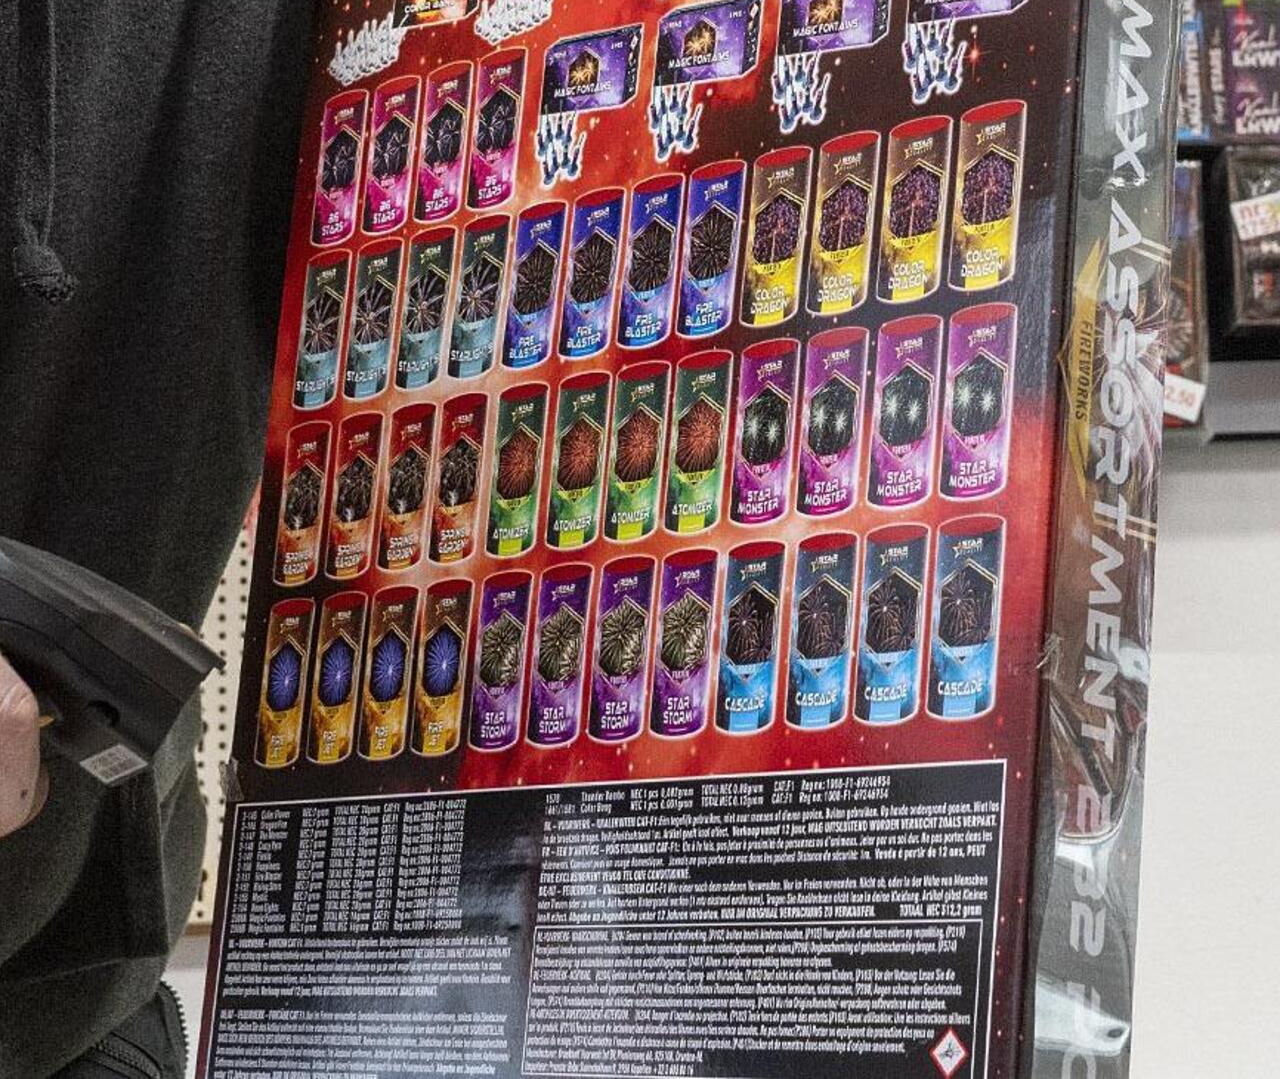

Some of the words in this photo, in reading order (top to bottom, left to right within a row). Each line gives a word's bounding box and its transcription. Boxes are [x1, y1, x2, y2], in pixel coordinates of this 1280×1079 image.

[1074, 321, 1094, 421] FIREWORKS
[958, 460, 987, 475] STAR
[886, 469, 913, 484] STAR
[949, 470, 996, 488] MONSTER
[1081, 197, 1144, 763] ASSORTMENT
[813, 479, 840, 494] STAR
[876, 480, 923, 498] MONSTER
[747, 489, 772, 503] STAR
[804, 490, 848, 507] MONSTER
[737, 499, 780, 516] MONSTER
[865, 683, 909, 702] CASCADE
[937, 676, 983, 697] CASCADE
[667, 696, 693, 711] STAR
[725, 694, 765, 712] CASCADE
[795, 688, 838, 706] CASCADE
[542, 706, 565, 721] STAR
[605, 701, 629, 716] STAR
[484, 712, 506, 726] STAR
